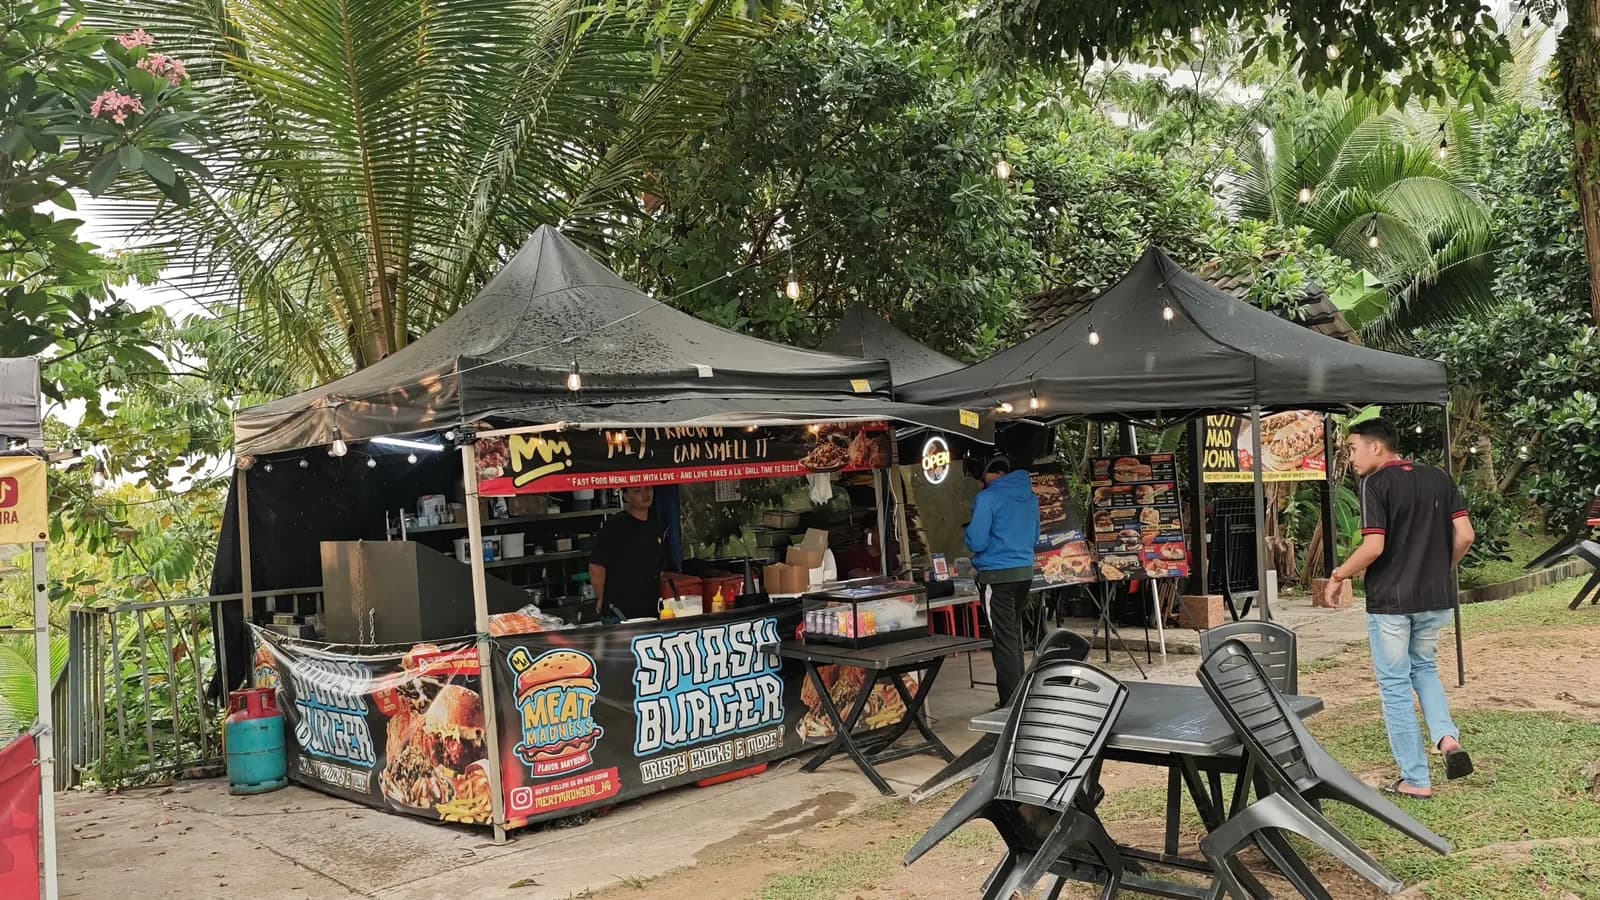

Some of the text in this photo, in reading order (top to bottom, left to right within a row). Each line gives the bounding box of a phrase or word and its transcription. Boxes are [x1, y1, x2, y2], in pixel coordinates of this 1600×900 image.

[673, 442, 700, 463] CAN
[704, 438, 749, 461] SMELL
[1205, 428, 1232, 448] MAD
[922, 450, 950, 471] OPEN
[1202, 449, 1236, 469] JOHN
[572, 477, 589, 486] FAST
[591, 476, 608, 485] FOOD
[643, 473, 658, 482] WITH
[660, 472, 675, 481] LOVE
[680, 471, 692, 479] AND
[693, 470, 708, 480] LOVE
[710, 469, 728, 477] TAKES
[633, 618, 782, 697] SMASH
[523, 691, 594, 729] MEAT
[636, 674, 784, 752] BURGER
[295, 704, 376, 764] BURGER
[526, 717, 594, 746] MADNESS
[640, 754, 688, 783] CRISPY
[689, 740, 733, 769] CHICKS
